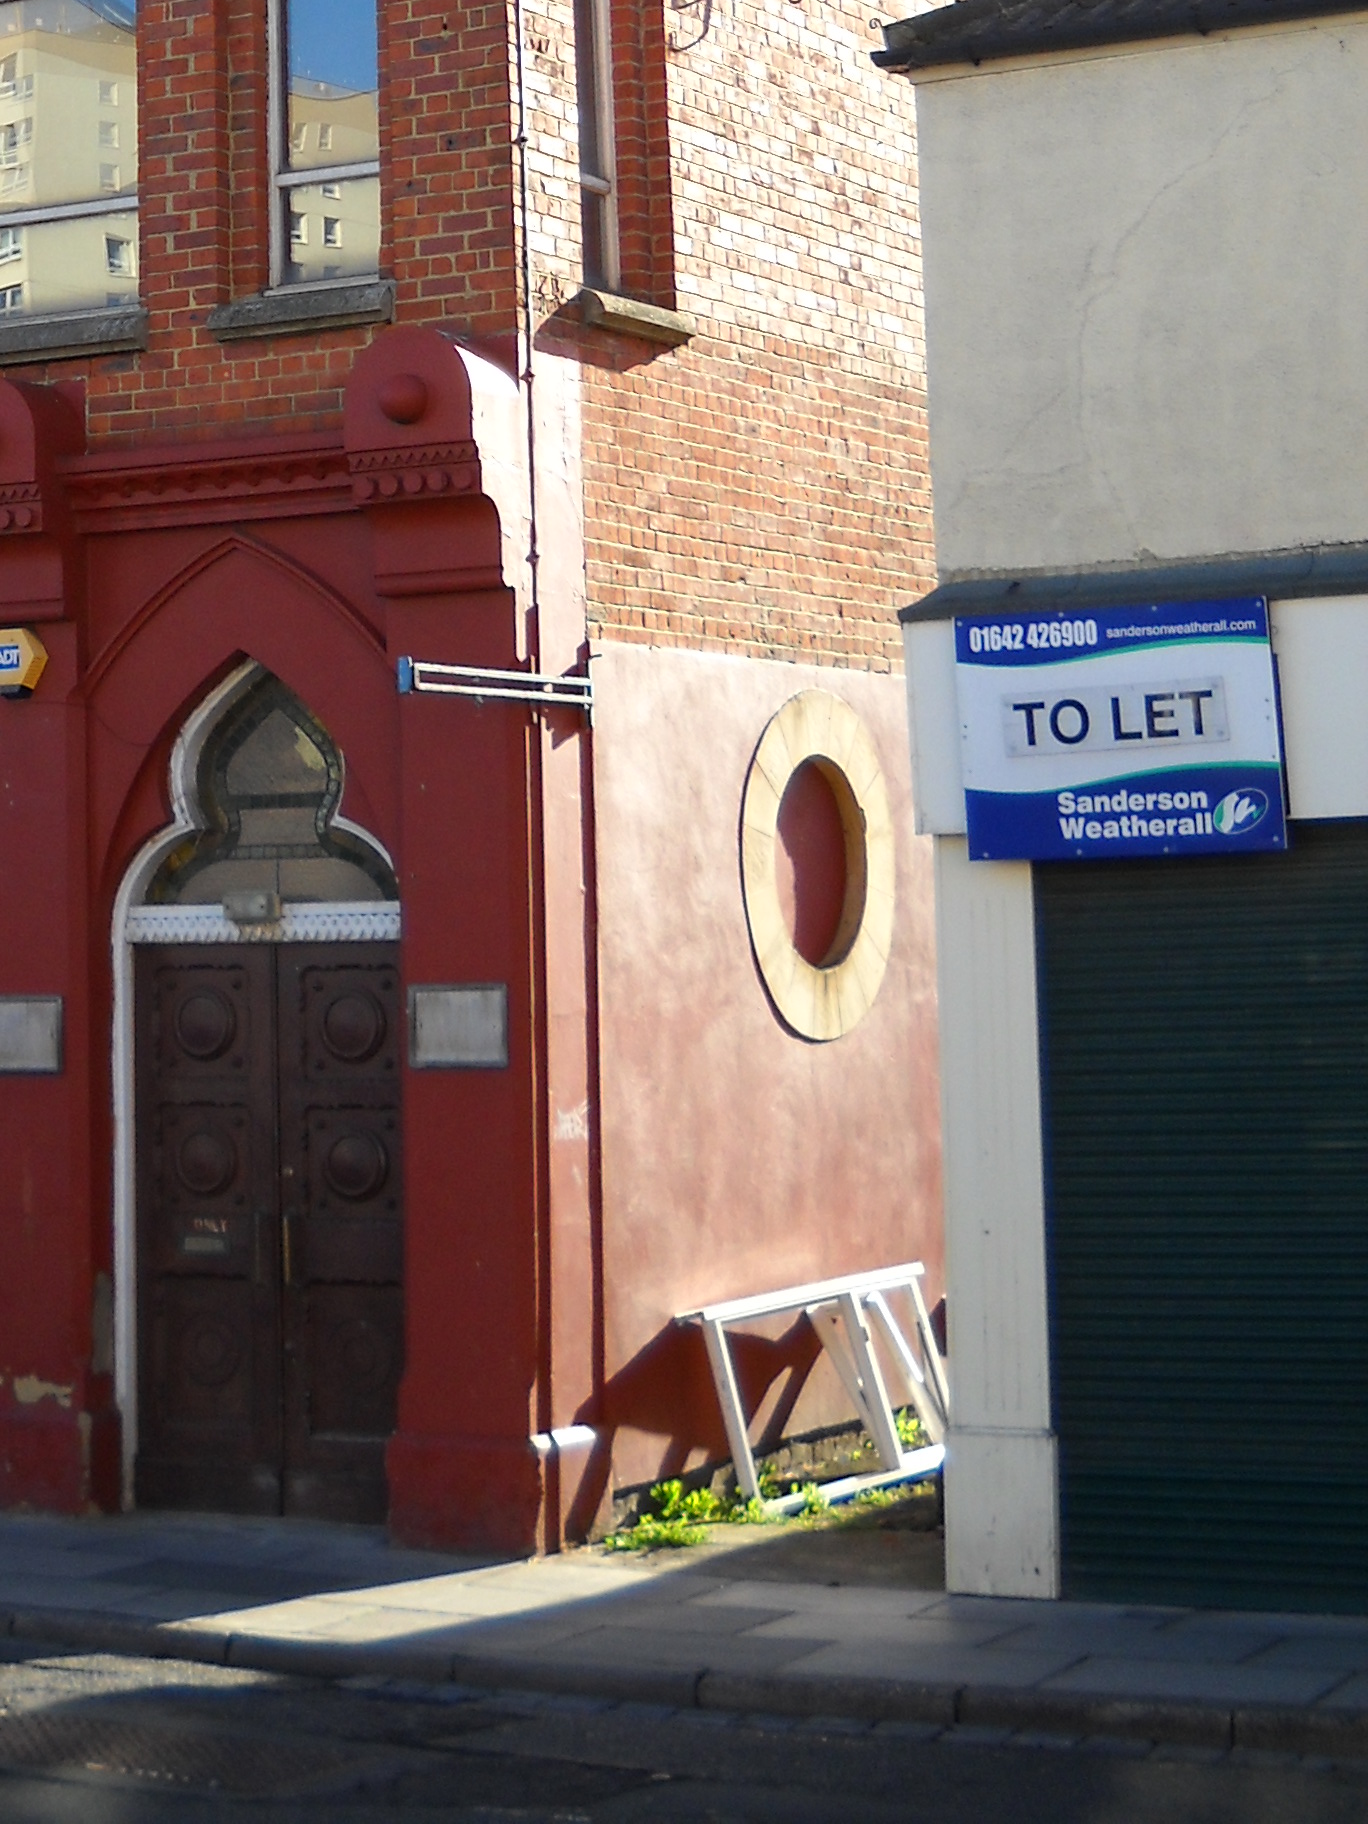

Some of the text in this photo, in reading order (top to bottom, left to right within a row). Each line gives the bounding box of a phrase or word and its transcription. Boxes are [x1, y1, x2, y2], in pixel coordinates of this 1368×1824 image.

[969, 619, 1257, 653] 01642 426900 sandersonweatherall.com
[1012, 689, 1213, 747] TO LET
[1057, 789, 1209, 815] Sanderson
[1059, 810, 1214, 841] Weatherall
